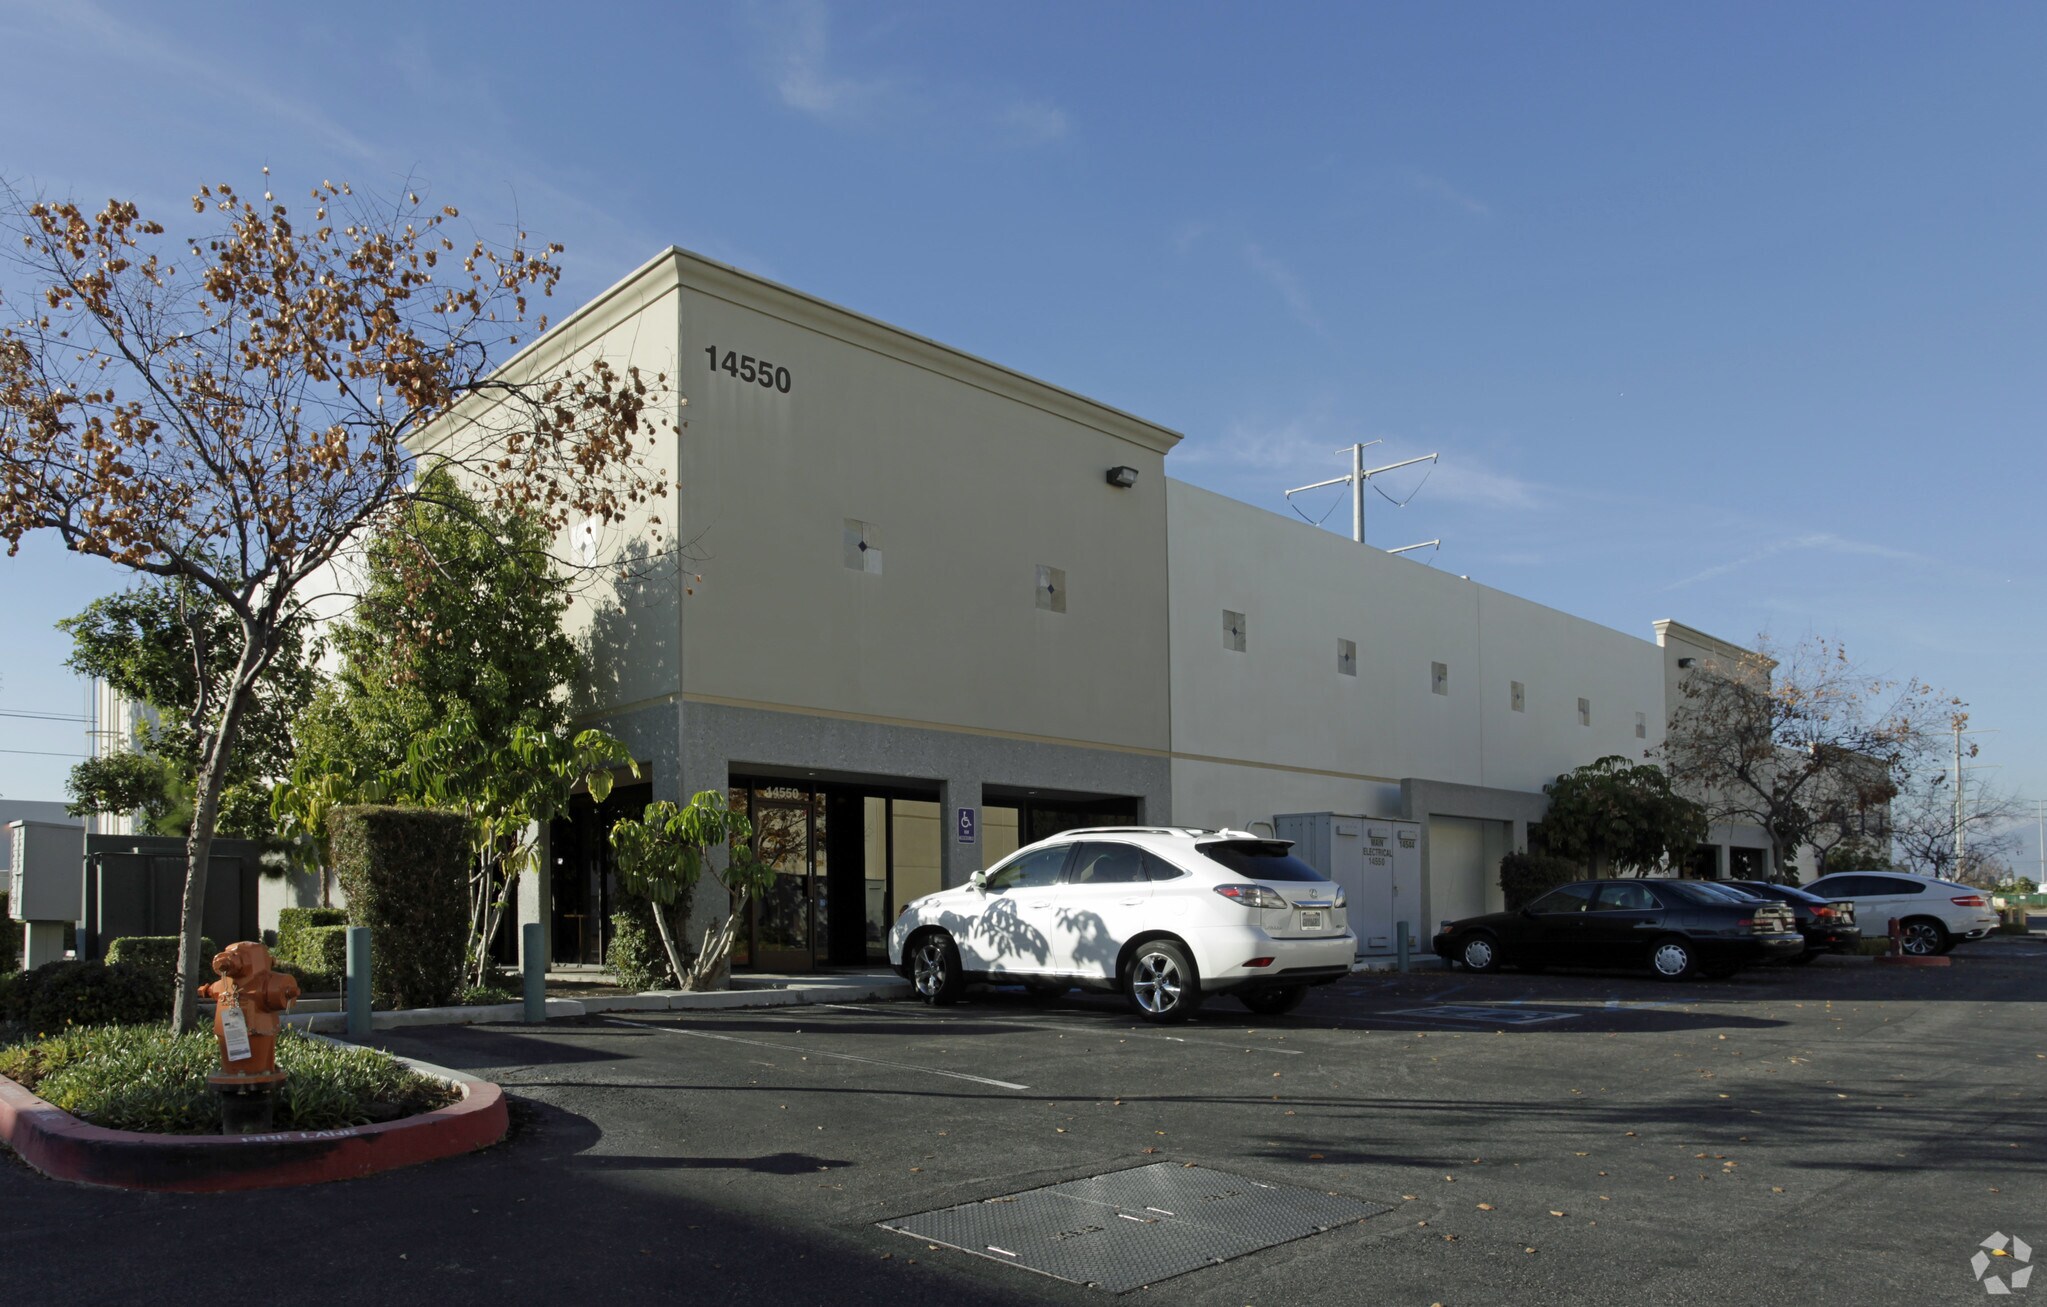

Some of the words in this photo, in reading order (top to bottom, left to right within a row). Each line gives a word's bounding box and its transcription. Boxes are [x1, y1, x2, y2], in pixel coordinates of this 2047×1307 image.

[705, 345, 791, 394] 14550
[766, 786, 799, 799] 14550
[1371, 838, 1384, 847] MAIN
[1362, 848, 1393, 857] ELECTRICAL
[300, 1129, 358, 1138] LANE
